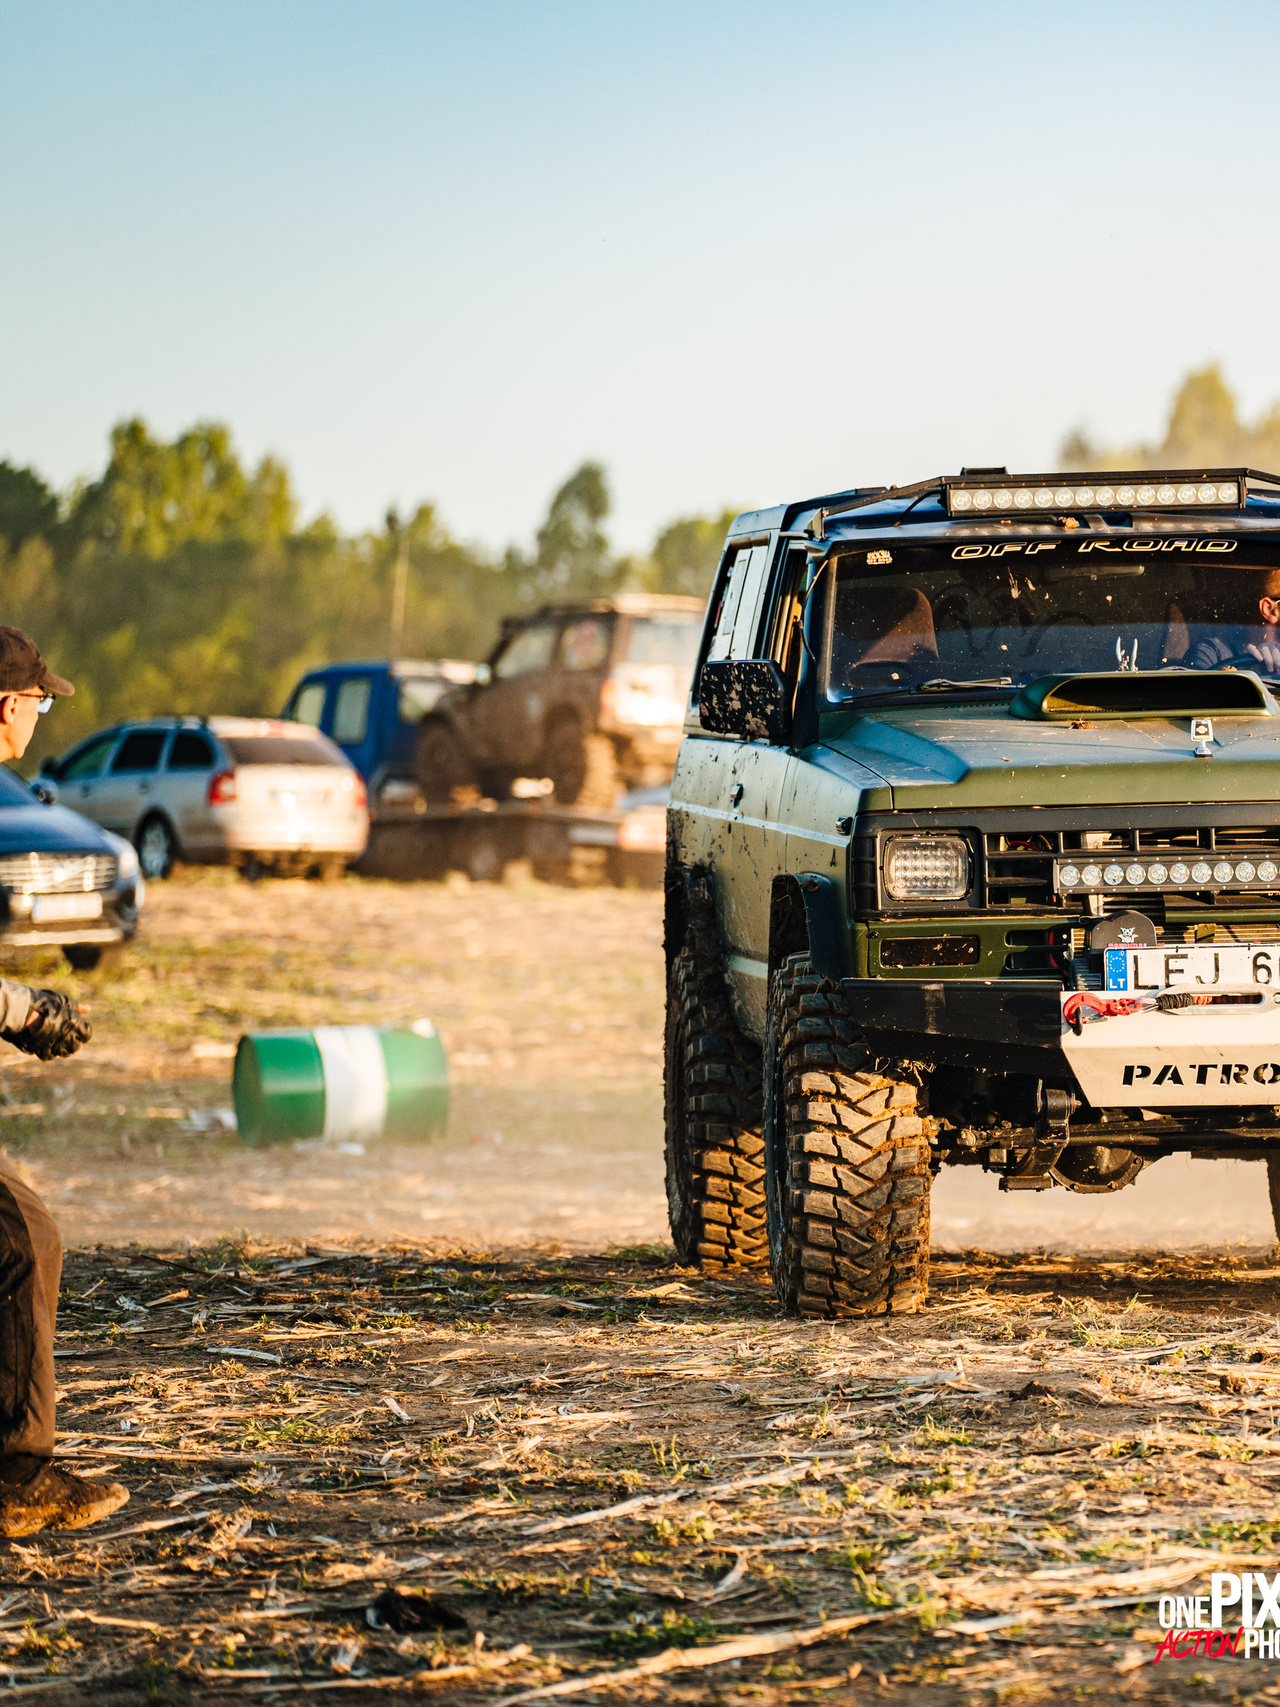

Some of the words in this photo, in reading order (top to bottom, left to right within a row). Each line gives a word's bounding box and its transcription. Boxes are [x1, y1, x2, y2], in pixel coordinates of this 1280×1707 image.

[951, 540, 1061, 560] OFF
[1078, 538, 1239, 553] ROAD
[1109, 977, 1126, 989] LT
[1133, 953, 1220, 990] LEJ
